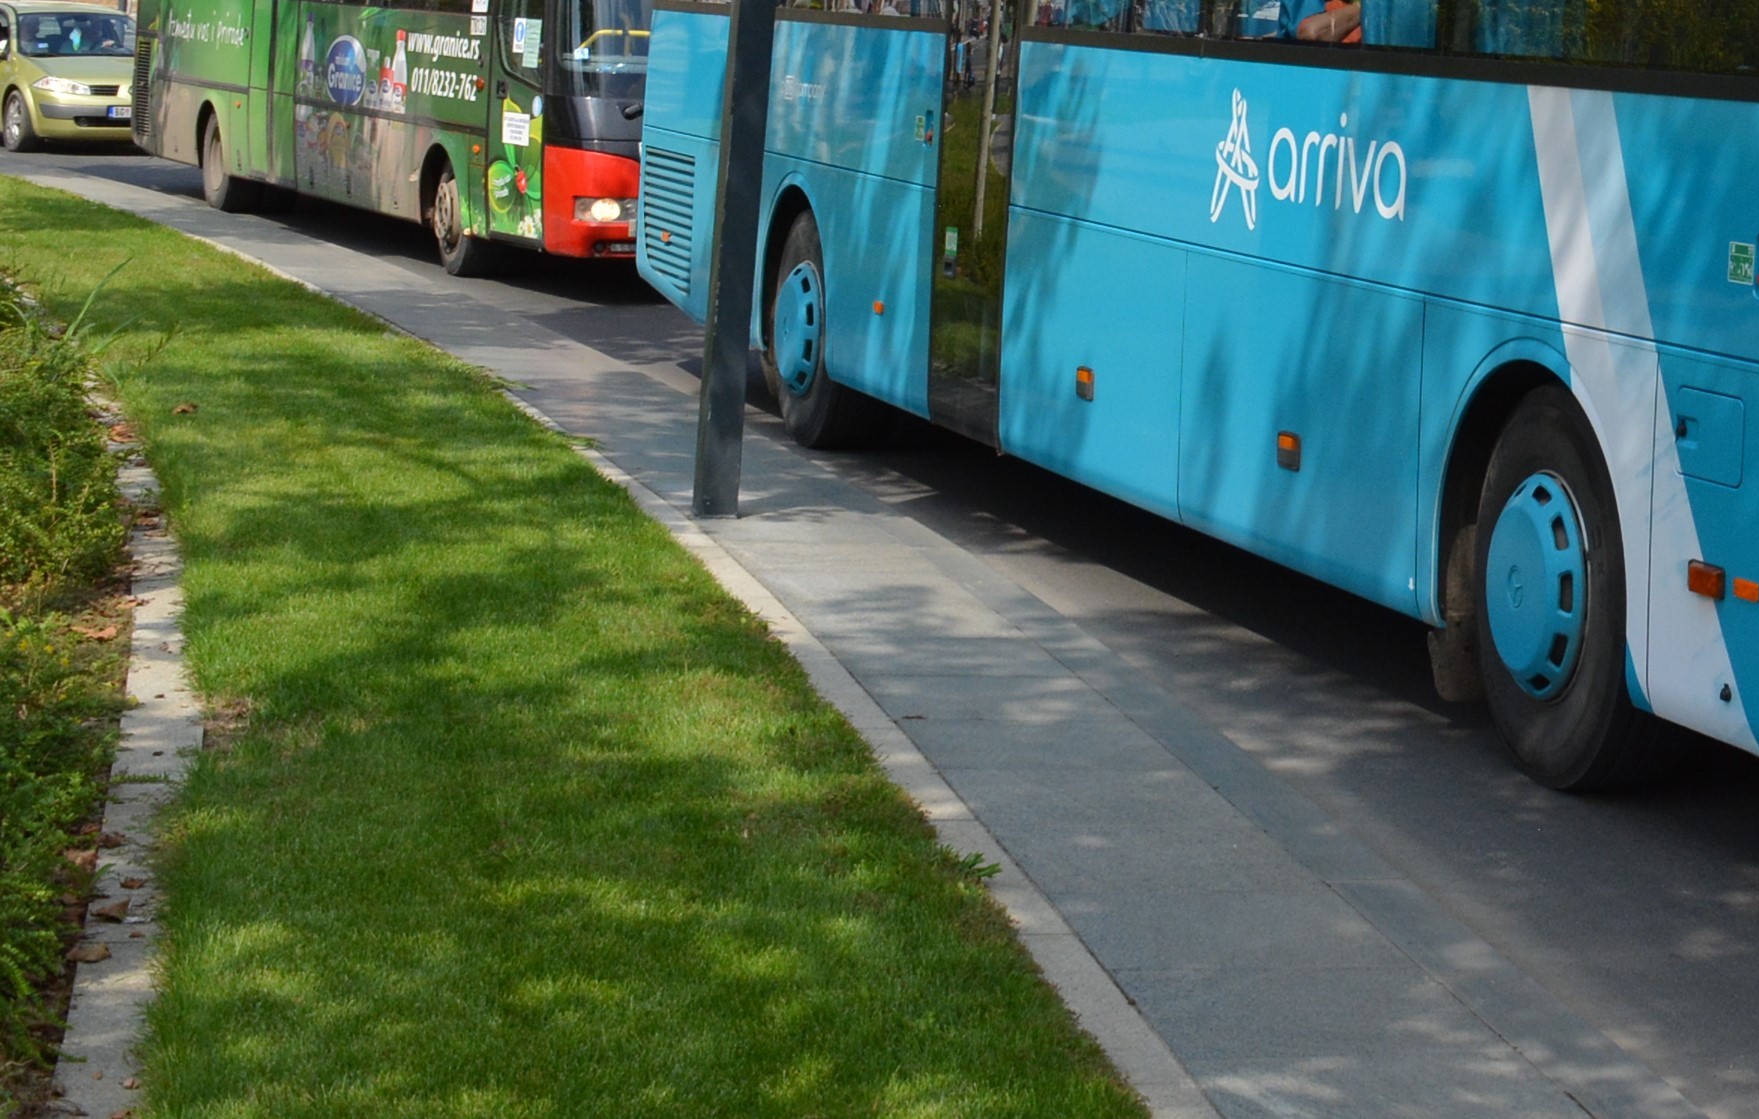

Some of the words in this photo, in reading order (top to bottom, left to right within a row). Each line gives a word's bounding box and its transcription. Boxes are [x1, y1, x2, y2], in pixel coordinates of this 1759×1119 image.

[408, 30, 481, 62] www.granice.rs
[327, 62, 362, 92] Granice
[411, 67, 478, 102] 011/8232-762
[1268, 111, 1407, 222] arriva
